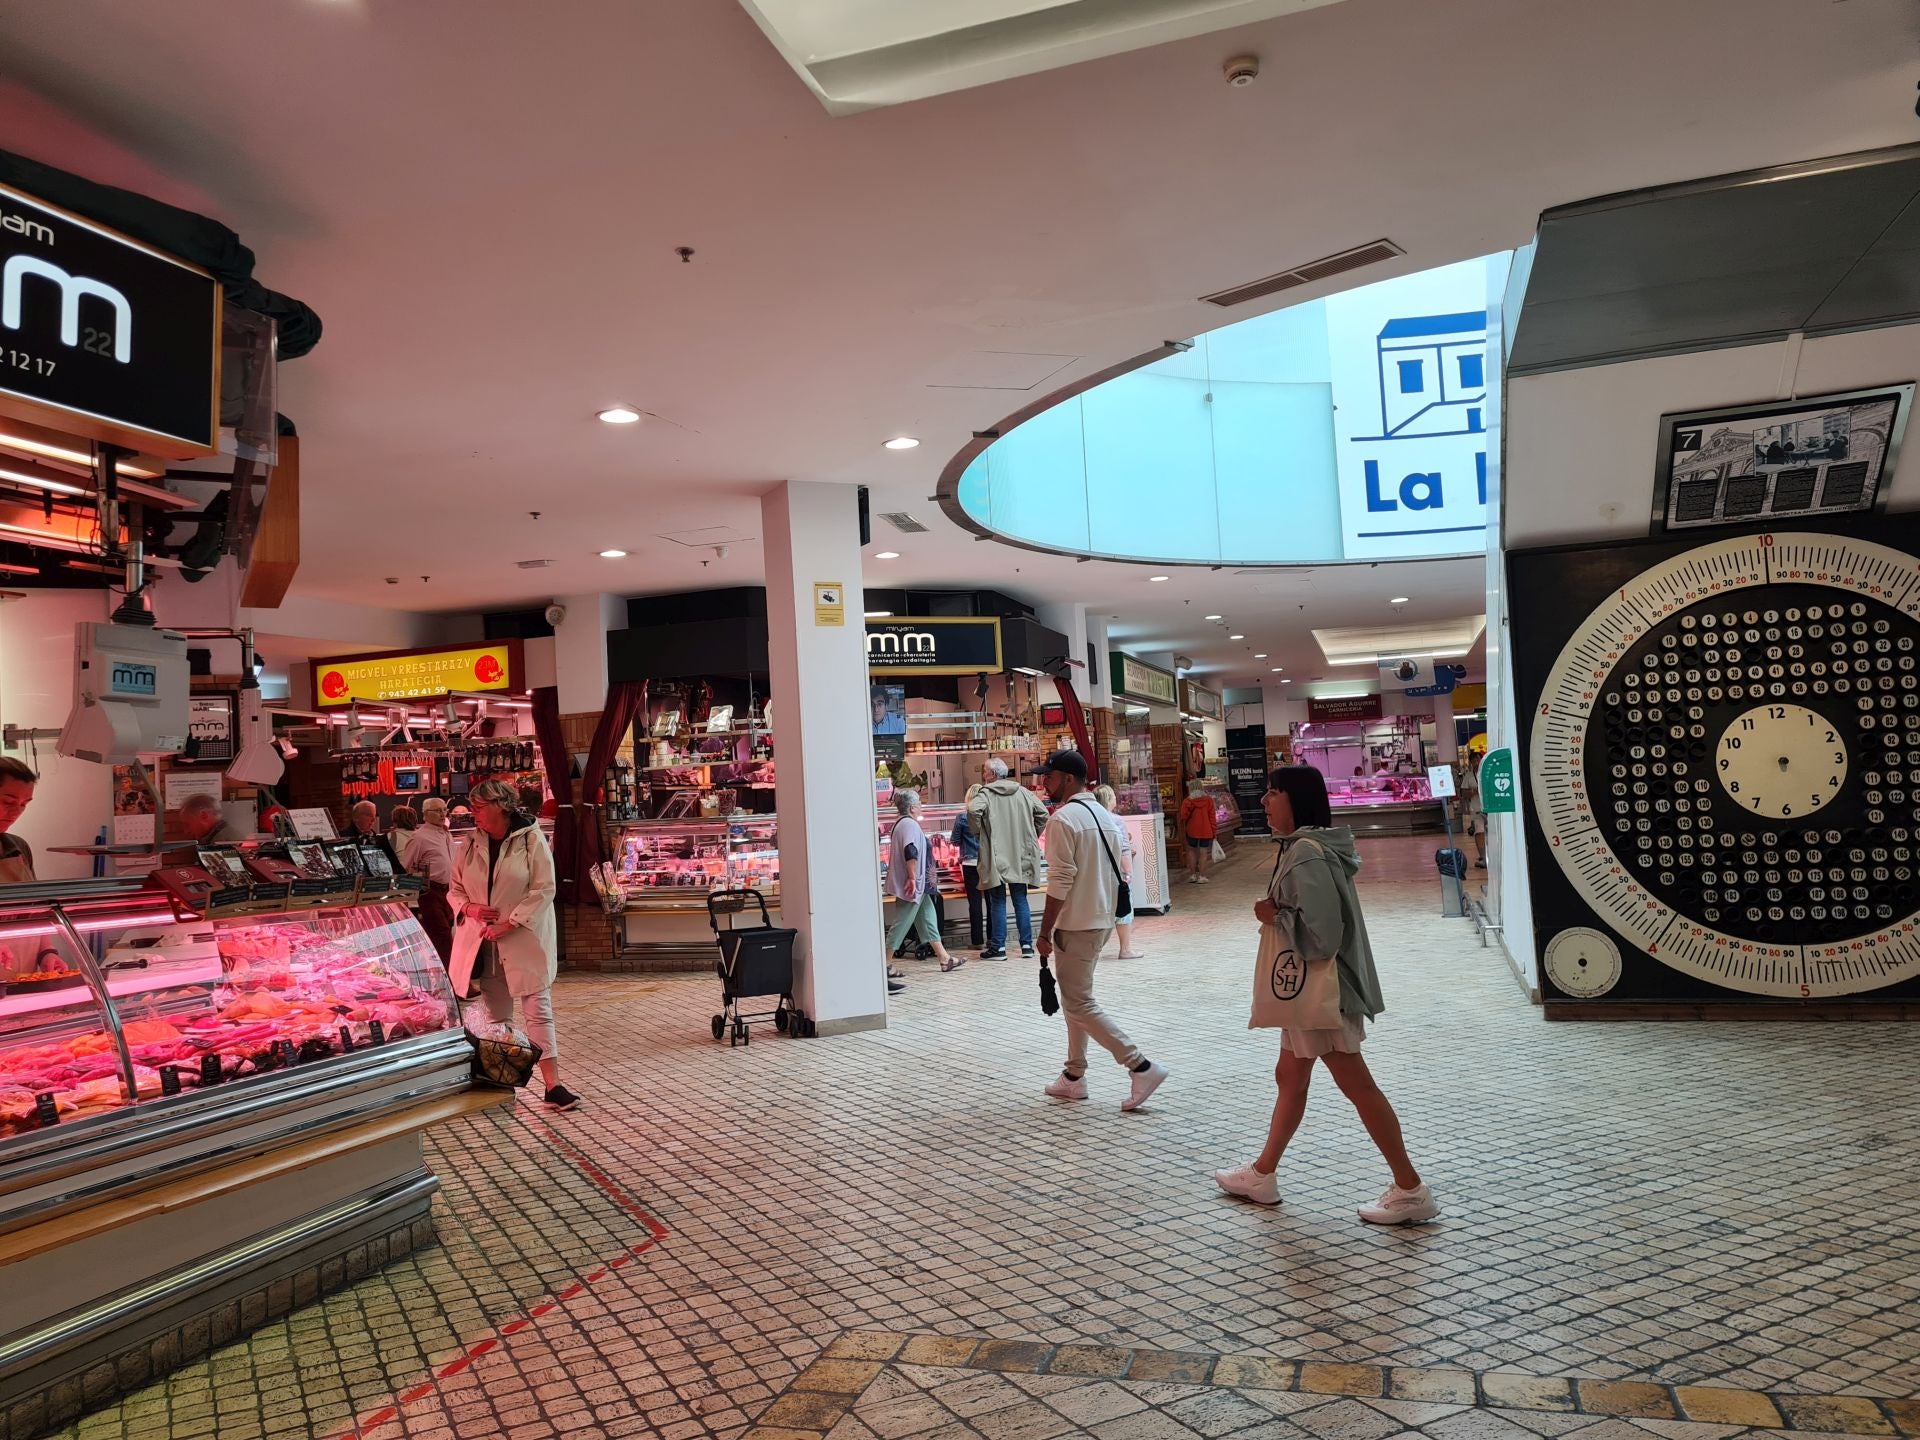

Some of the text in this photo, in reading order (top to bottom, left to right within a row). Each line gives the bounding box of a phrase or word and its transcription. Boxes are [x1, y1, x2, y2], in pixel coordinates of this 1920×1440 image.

[0, 209, 54, 246] am
[84, 327, 112, 357] 22
[10, 350, 30, 371] 12
[36, 358, 56, 377] 17
[1681, 433, 1696, 449] 7
[1364, 460, 1444, 513] La
[1758, 535, 1773, 547] 10
[1736, 576, 1746, 584] 20
[1803, 571, 1814, 579] 70
[1723, 579, 1733, 587] 30
[1620, 590, 1624, 601] 1
[1698, 587, 1708, 595] 50
[1600, 661, 1610, 669] 50
[389, 686, 446, 698] 943 42 41 59
[1541, 703, 1549, 715] 2
[1768, 707, 1785, 719] 12
[1741, 719, 1754, 730] 11
[1808, 714, 1813, 726] 1
[1725, 737, 1741, 749] 10
[1825, 731, 1835, 743] 2
[1835, 752, 1844, 764] 3
[1720, 759, 1729, 770] 9
[1731, 781, 1739, 793] 8
[1829, 776, 1838, 787] 4
[1752, 797, 1760, 809] 7
[1811, 794, 1820, 806] 5
[1782, 804, 1791, 815] 6
[1552, 836, 1560, 847] 3
[1679, 922, 1689, 930] 10
[1703, 933, 1714, 941] 30
[1648, 943, 1657, 953] 4
[1801, 985, 1810, 997] 5
